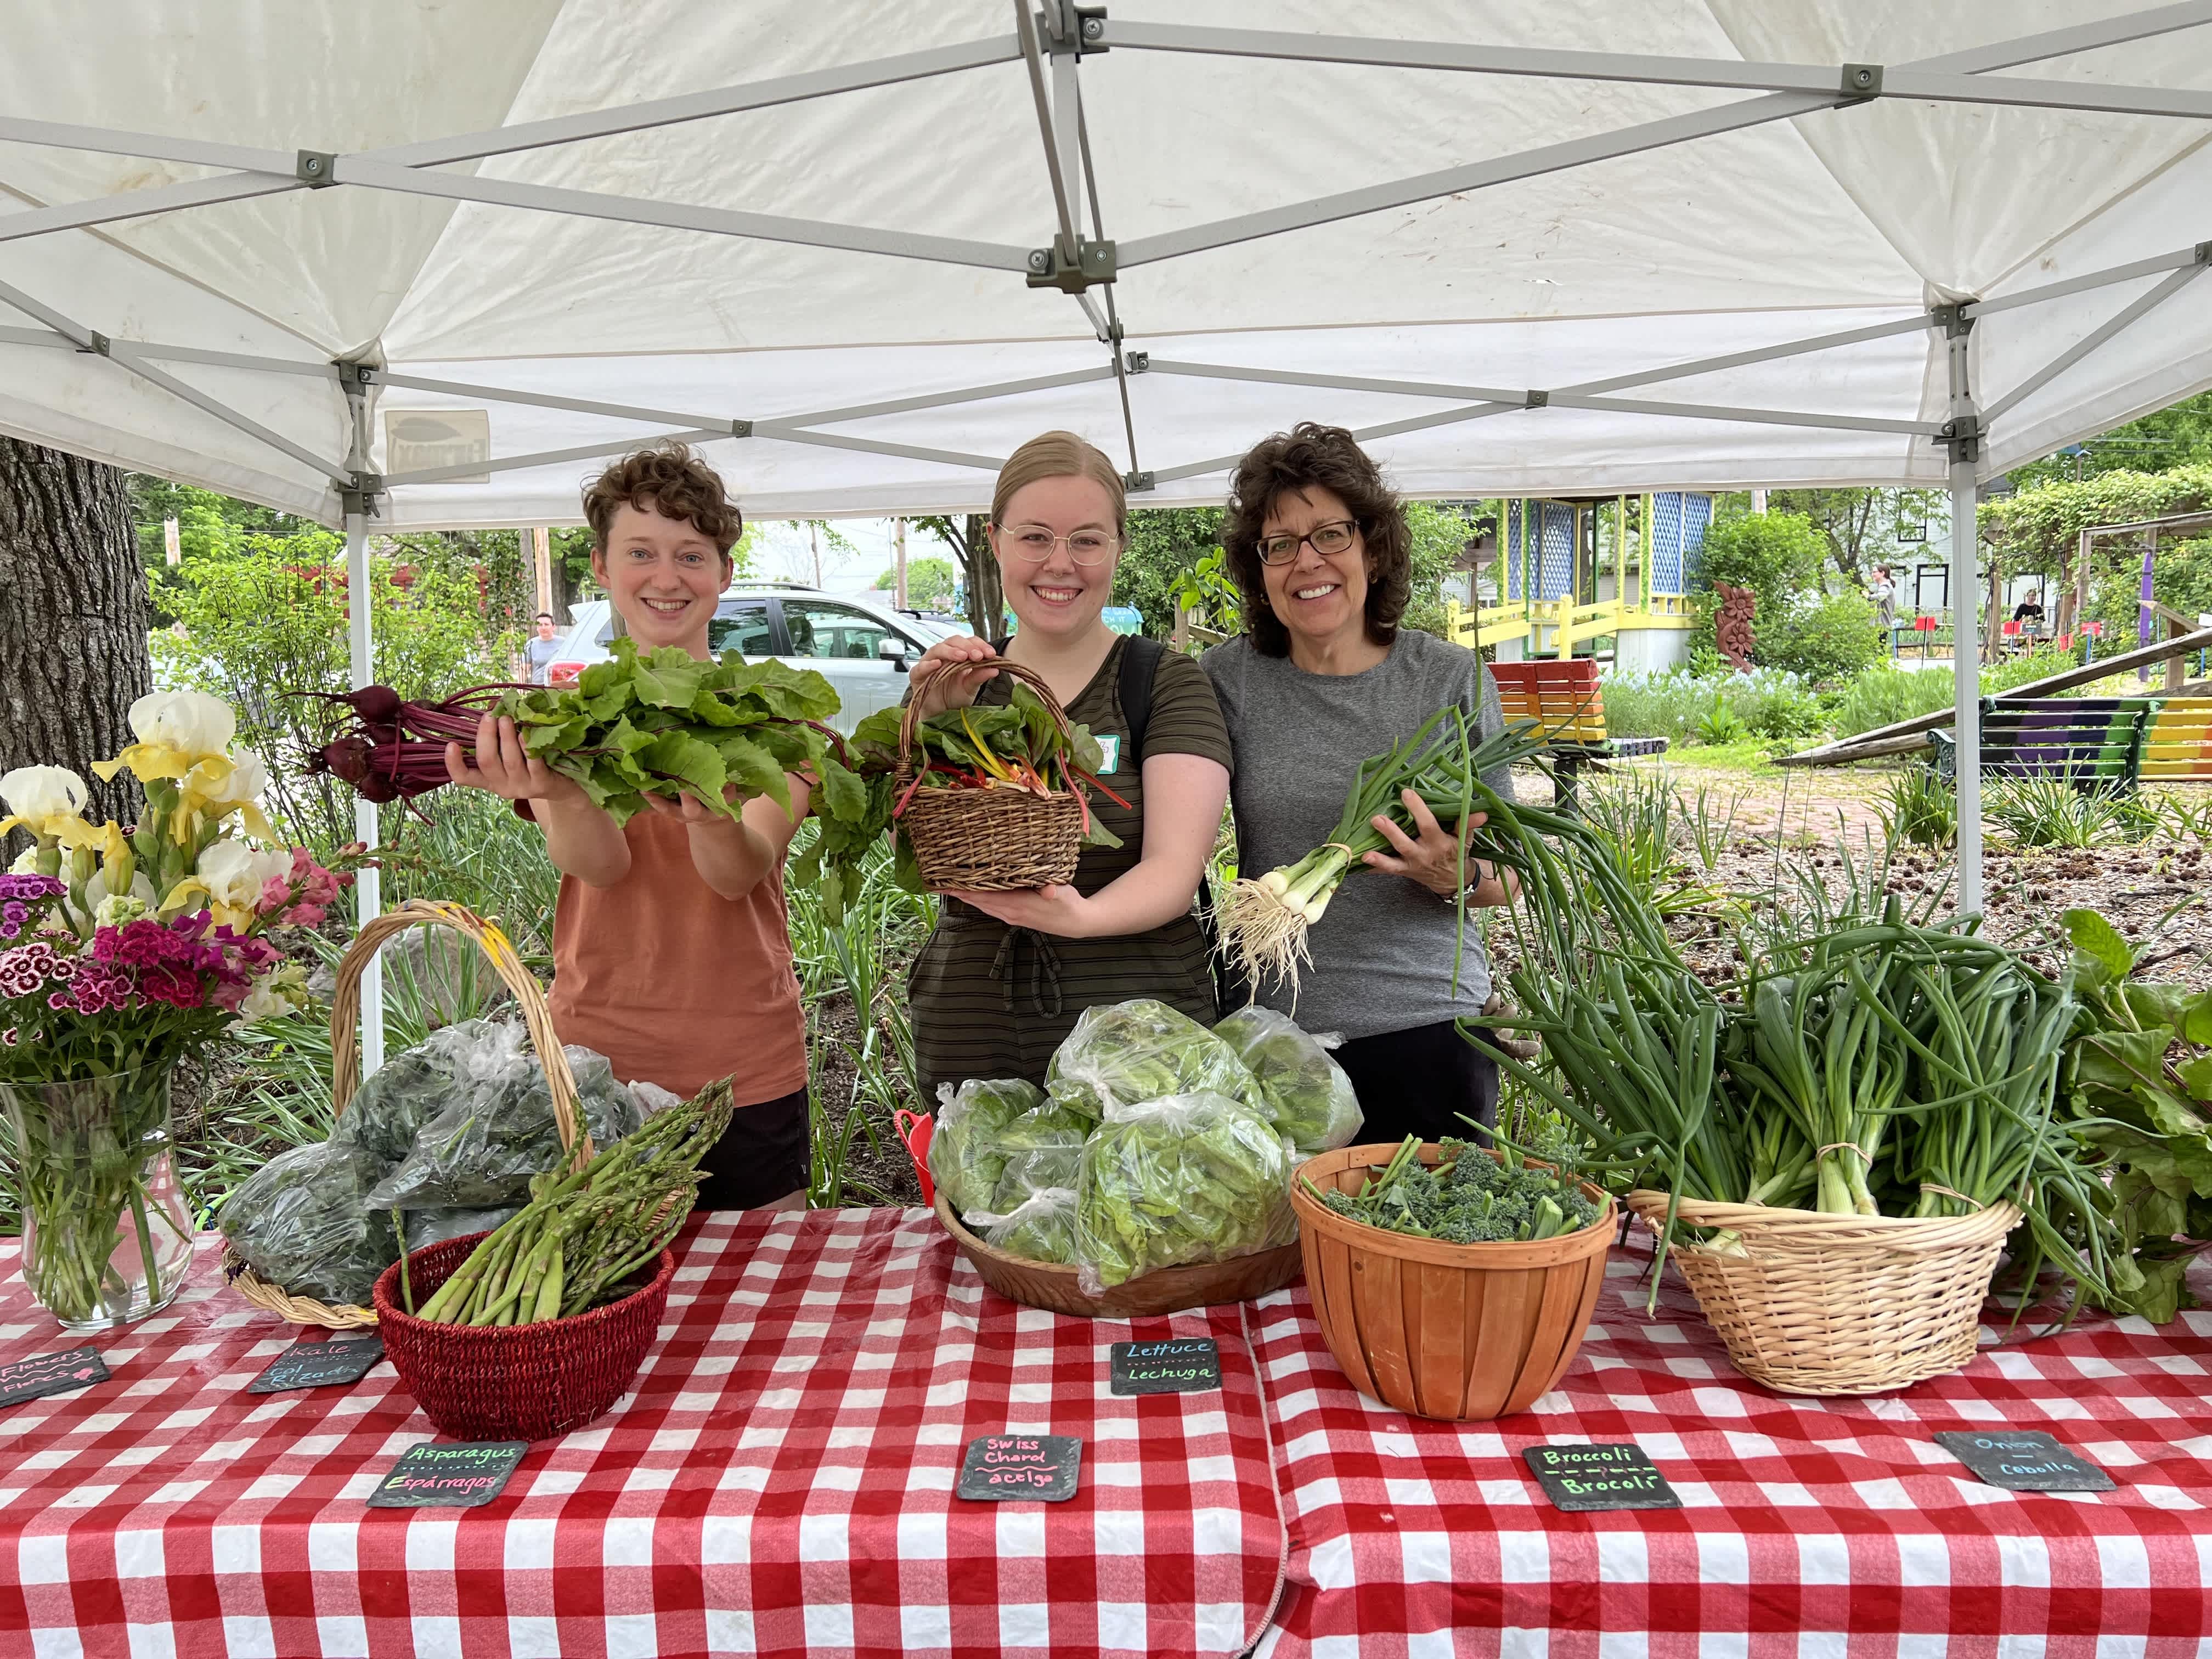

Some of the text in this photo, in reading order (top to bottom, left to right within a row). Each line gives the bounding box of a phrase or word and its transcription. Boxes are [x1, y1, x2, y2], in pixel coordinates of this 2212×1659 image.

[289, 1344, 351, 1357] Kale
[1126, 1342, 1211, 1358] Lettuce
[1, 1350, 83, 1378] Flowers
[1128, 1367, 1215, 1380] Lechuga
[3, 1370, 69, 1393] Flores
[987, 1437, 1040, 1451] Swiss
[1975, 1438, 2045, 1449] Onion
[407, 1447, 516, 1465] Asparagus
[984, 1451, 1046, 1463] Chard
[1543, 1446, 1632, 1465] Broccoli
[2000, 1462, 2080, 1475] Cebolla
[384, 1475, 496, 1495] Espárragos
